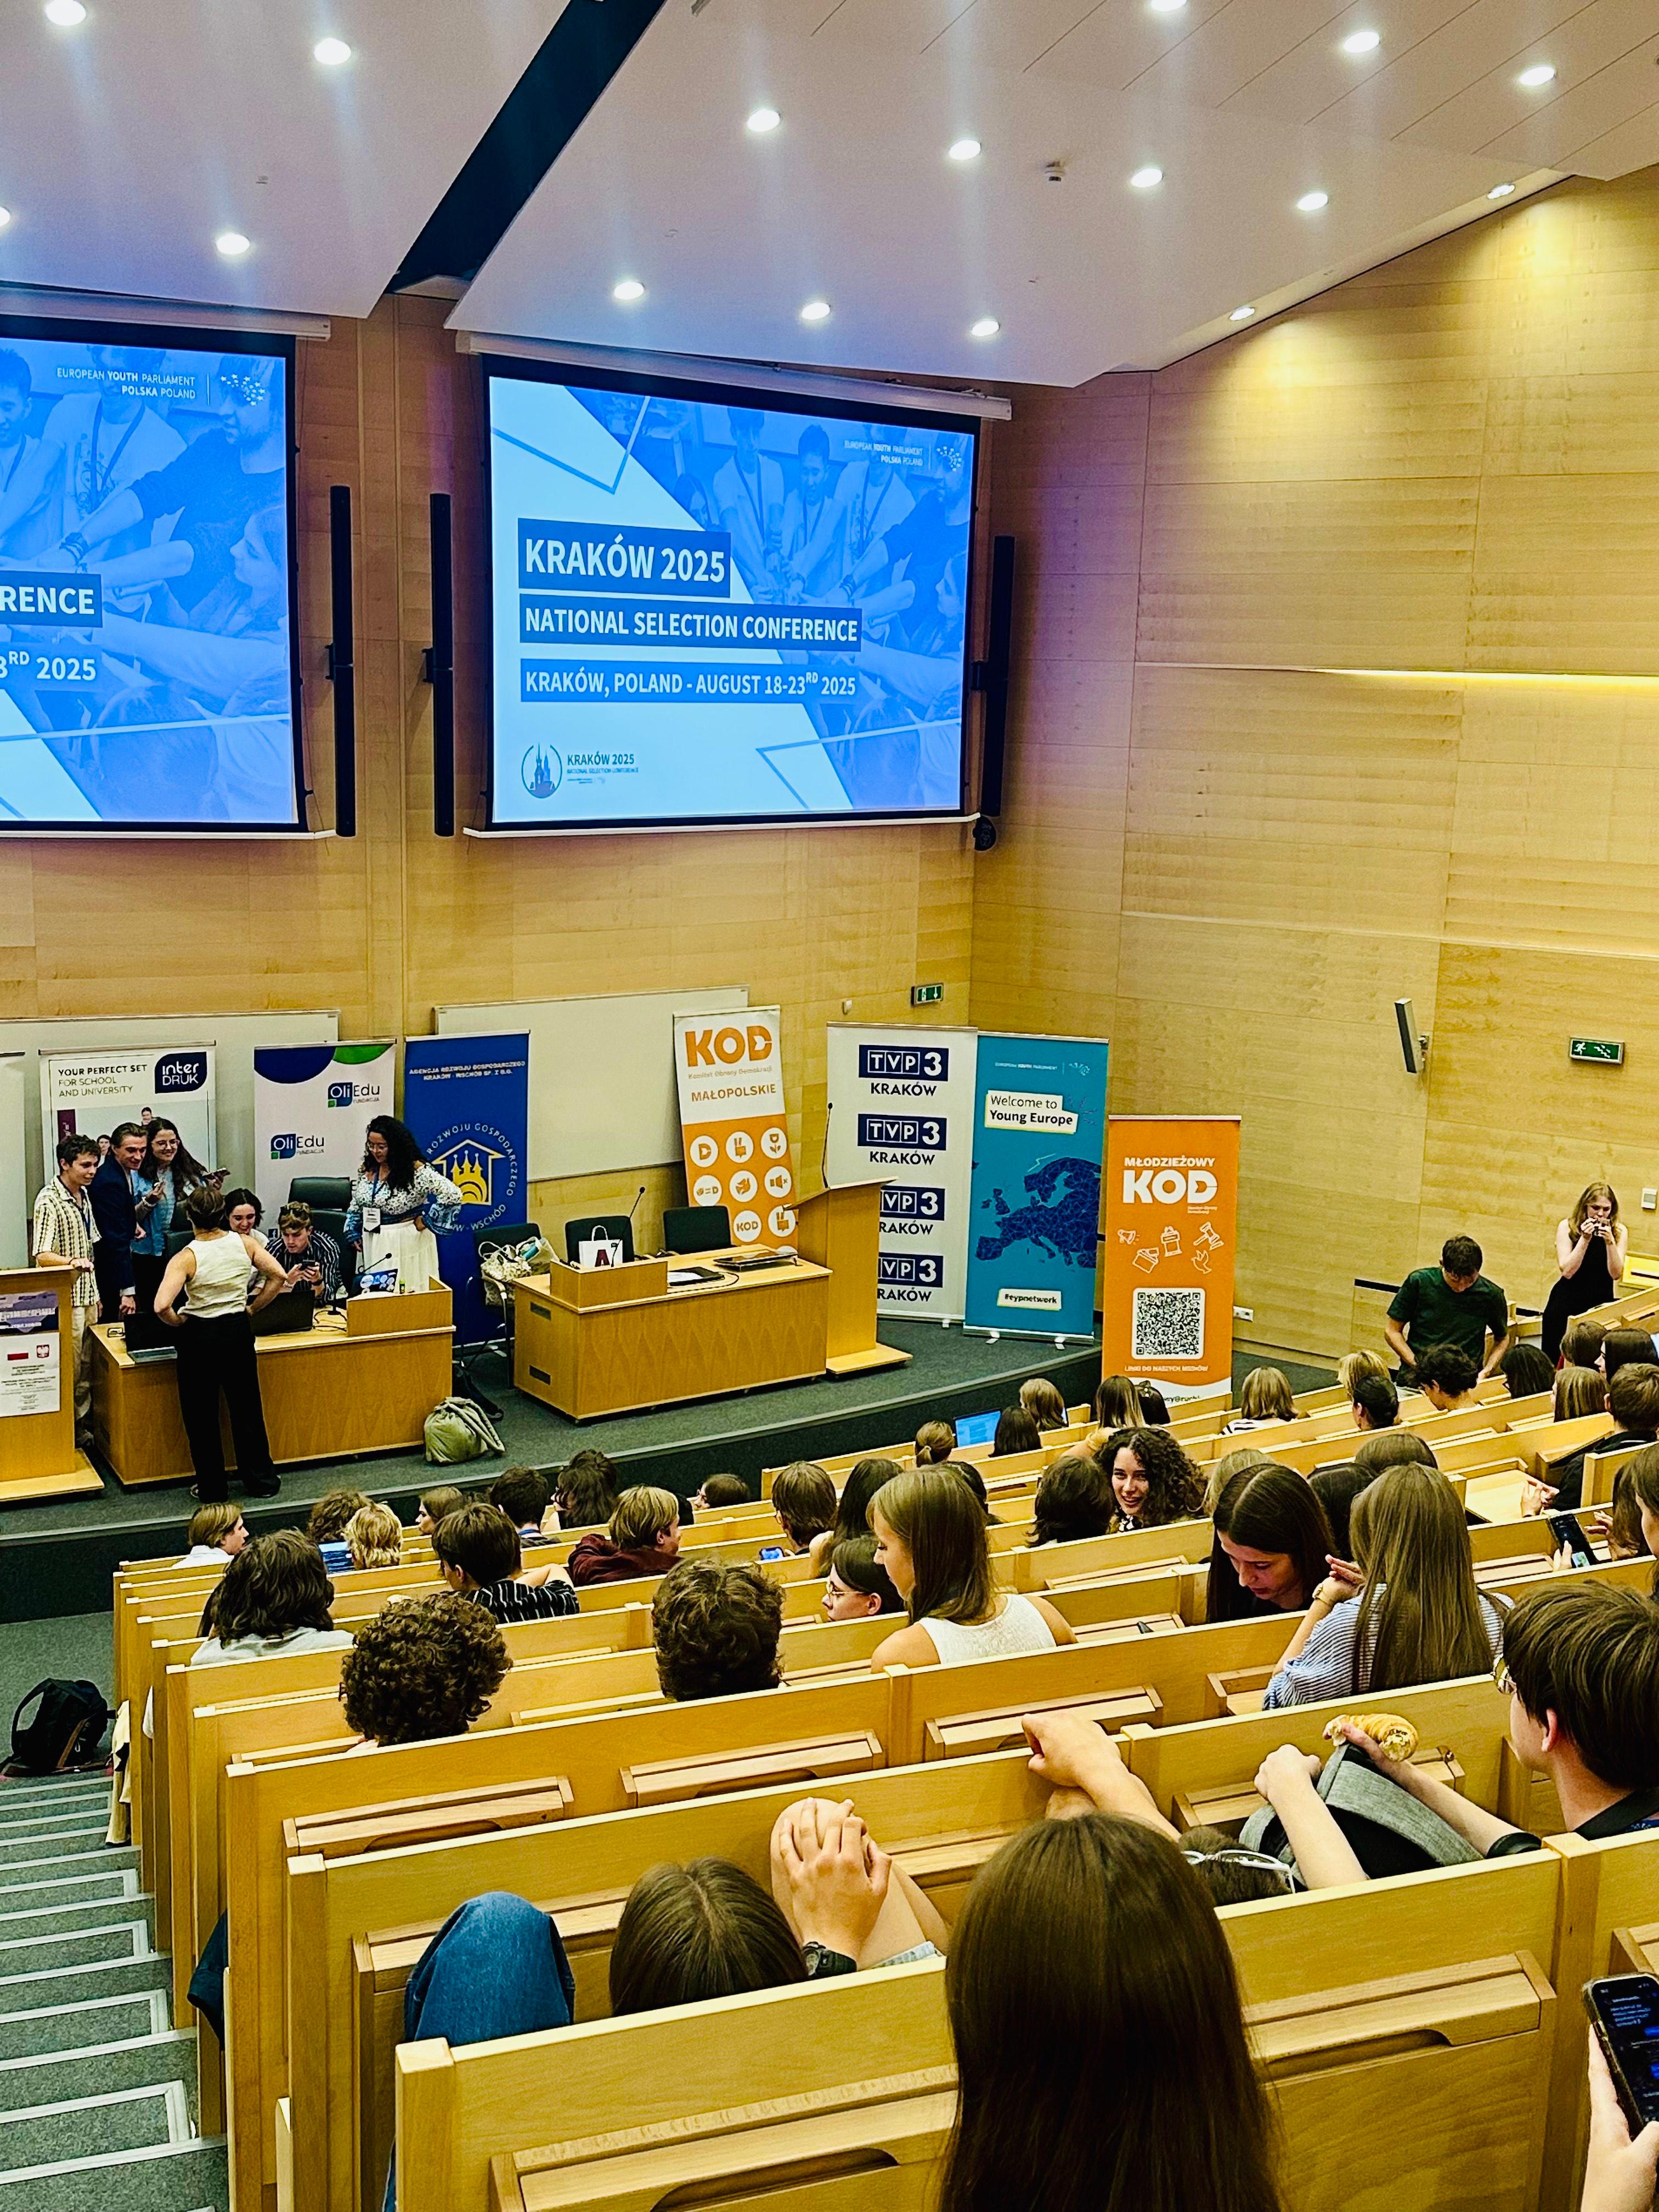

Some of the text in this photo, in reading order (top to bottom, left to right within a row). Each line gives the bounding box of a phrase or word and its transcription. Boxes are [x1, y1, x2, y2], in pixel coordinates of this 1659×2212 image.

[57, 367, 195, 386] EUROPEAN YOUTH PARLIAMENT
[122, 385, 195, 399] POLSKA POLAND
[526, 533, 725, 583] KRAKÓW 2025
[526, 608, 857, 641] NATIONAL SELECTION CONFERENCE
[36, 657, 96, 680] 2025
[526, 666, 610, 698] KRAKÓW,
[614, 673, 682, 693] POLAND
[695, 674, 760, 695] AUGUST
[821, 676, 855, 695] 2025
[567, 751, 634, 765] KRAKÓW 2025
[685, 1025, 772, 1067] KOD
[88, 1066, 126, 1074] PERFECT
[131, 1064, 147, 1072] SET
[79, 1077, 116, 1085] SCHOOL
[162, 1074, 199, 1086] DRUK
[59, 1086, 133, 1097] AND UNIVERSITY
[691, 1084, 776, 1102] MAŁOPOLSKIE
[871, 1082, 937, 1097] KRAKÓW
[991, 1095, 1057, 1109] Welcome to
[990, 1110, 1073, 1126] Young Europe
[426, 1123, 518, 1196] ROZWOJU GOSPODARCZEGO
[870, 1150, 935, 1165] KRAKÓW
[1125, 1155, 1215, 1167] MŁODZIEŻOWY
[1123, 1169, 1218, 1204] KOD
[737, 1221, 759, 1232] KOD
[879, 1220, 933, 1235] RAKÓW
[877, 1288, 932, 1302] RAKÓW
[1005, 1293, 1057, 1304] #eypnetwork
